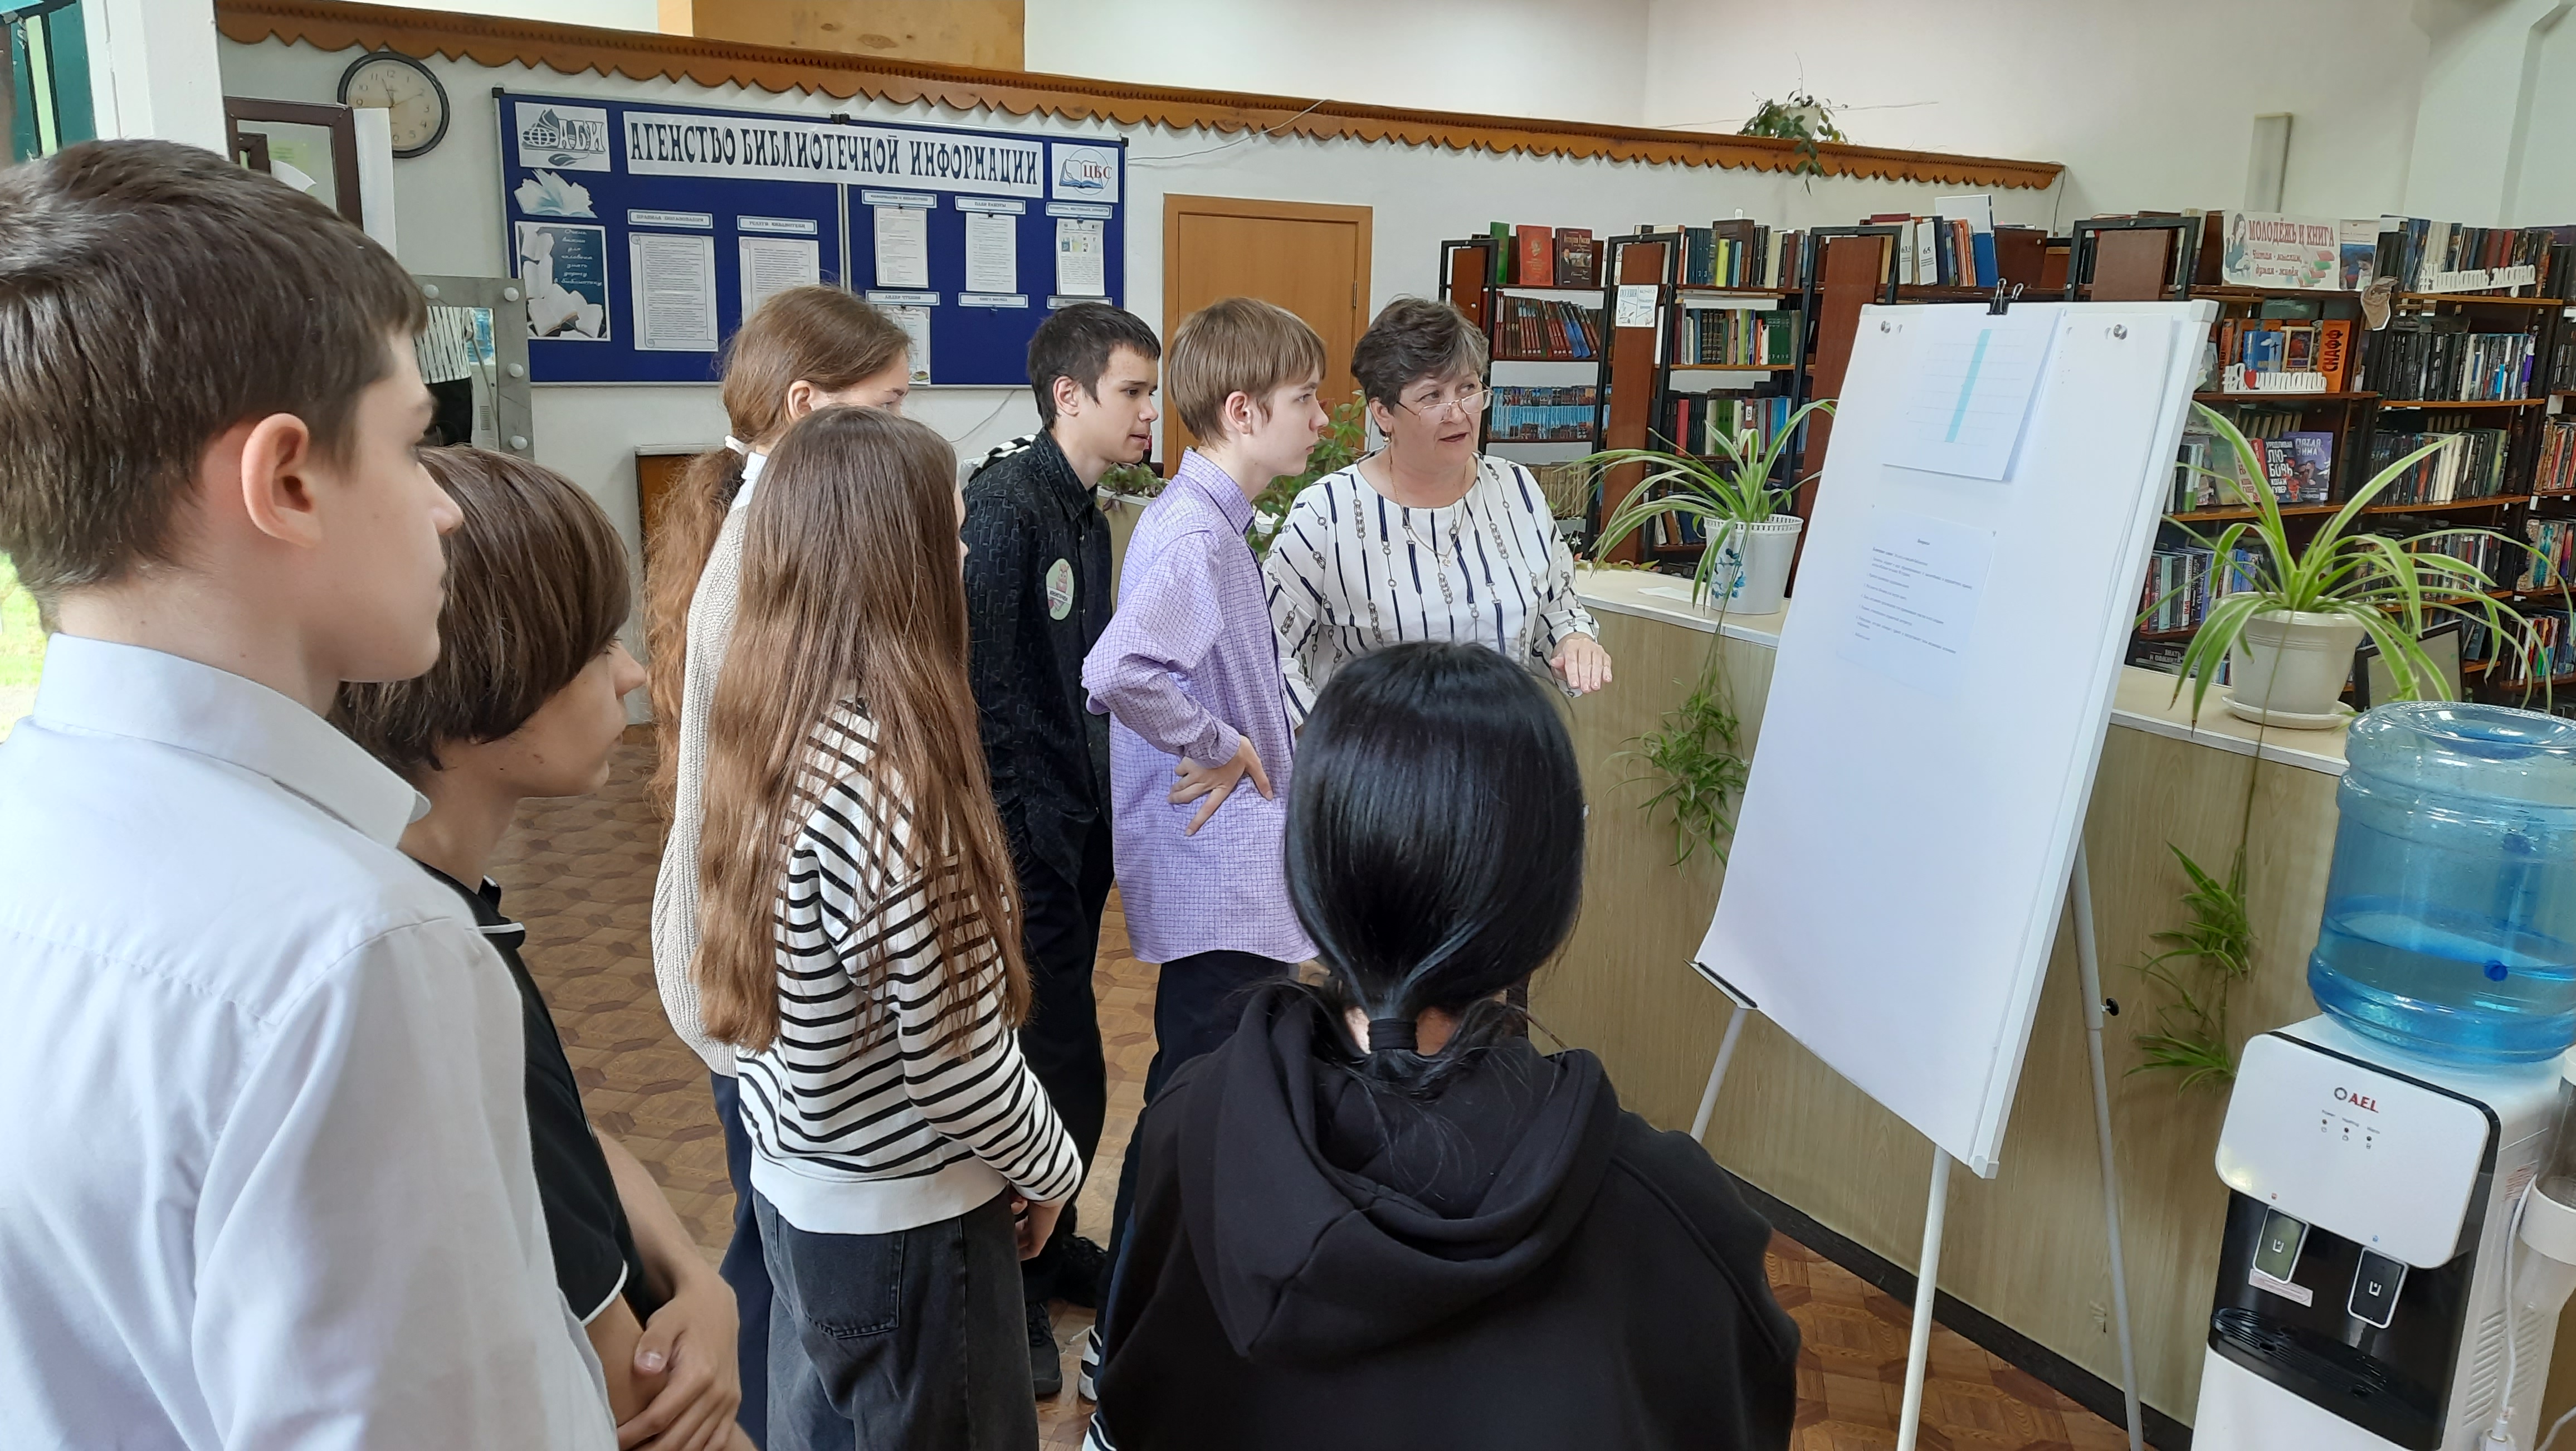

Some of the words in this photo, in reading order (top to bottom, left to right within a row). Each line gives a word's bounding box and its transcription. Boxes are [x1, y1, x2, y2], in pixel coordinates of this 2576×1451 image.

[557, 119, 606, 152] АБИ
[630, 122, 736, 165] АГЕНСТВО
[740, 128, 901, 174] БИБЛИОТЕЧНОЙ
[909, 140, 1038, 187] ИНФОРМАЦИИ
[1084, 164, 1113, 181] ЦБС
[2248, 217, 2297, 246] МОЛОДЁЖЬ
[2299, 224, 2305, 244] И
[2306, 225, 2335, 247] КНИГА
[2322, 329, 2344, 372] СНАФФ
[2267, 449, 2287, 463] ЛЮ-
[2268, 463, 2293, 478] БОВЬ
